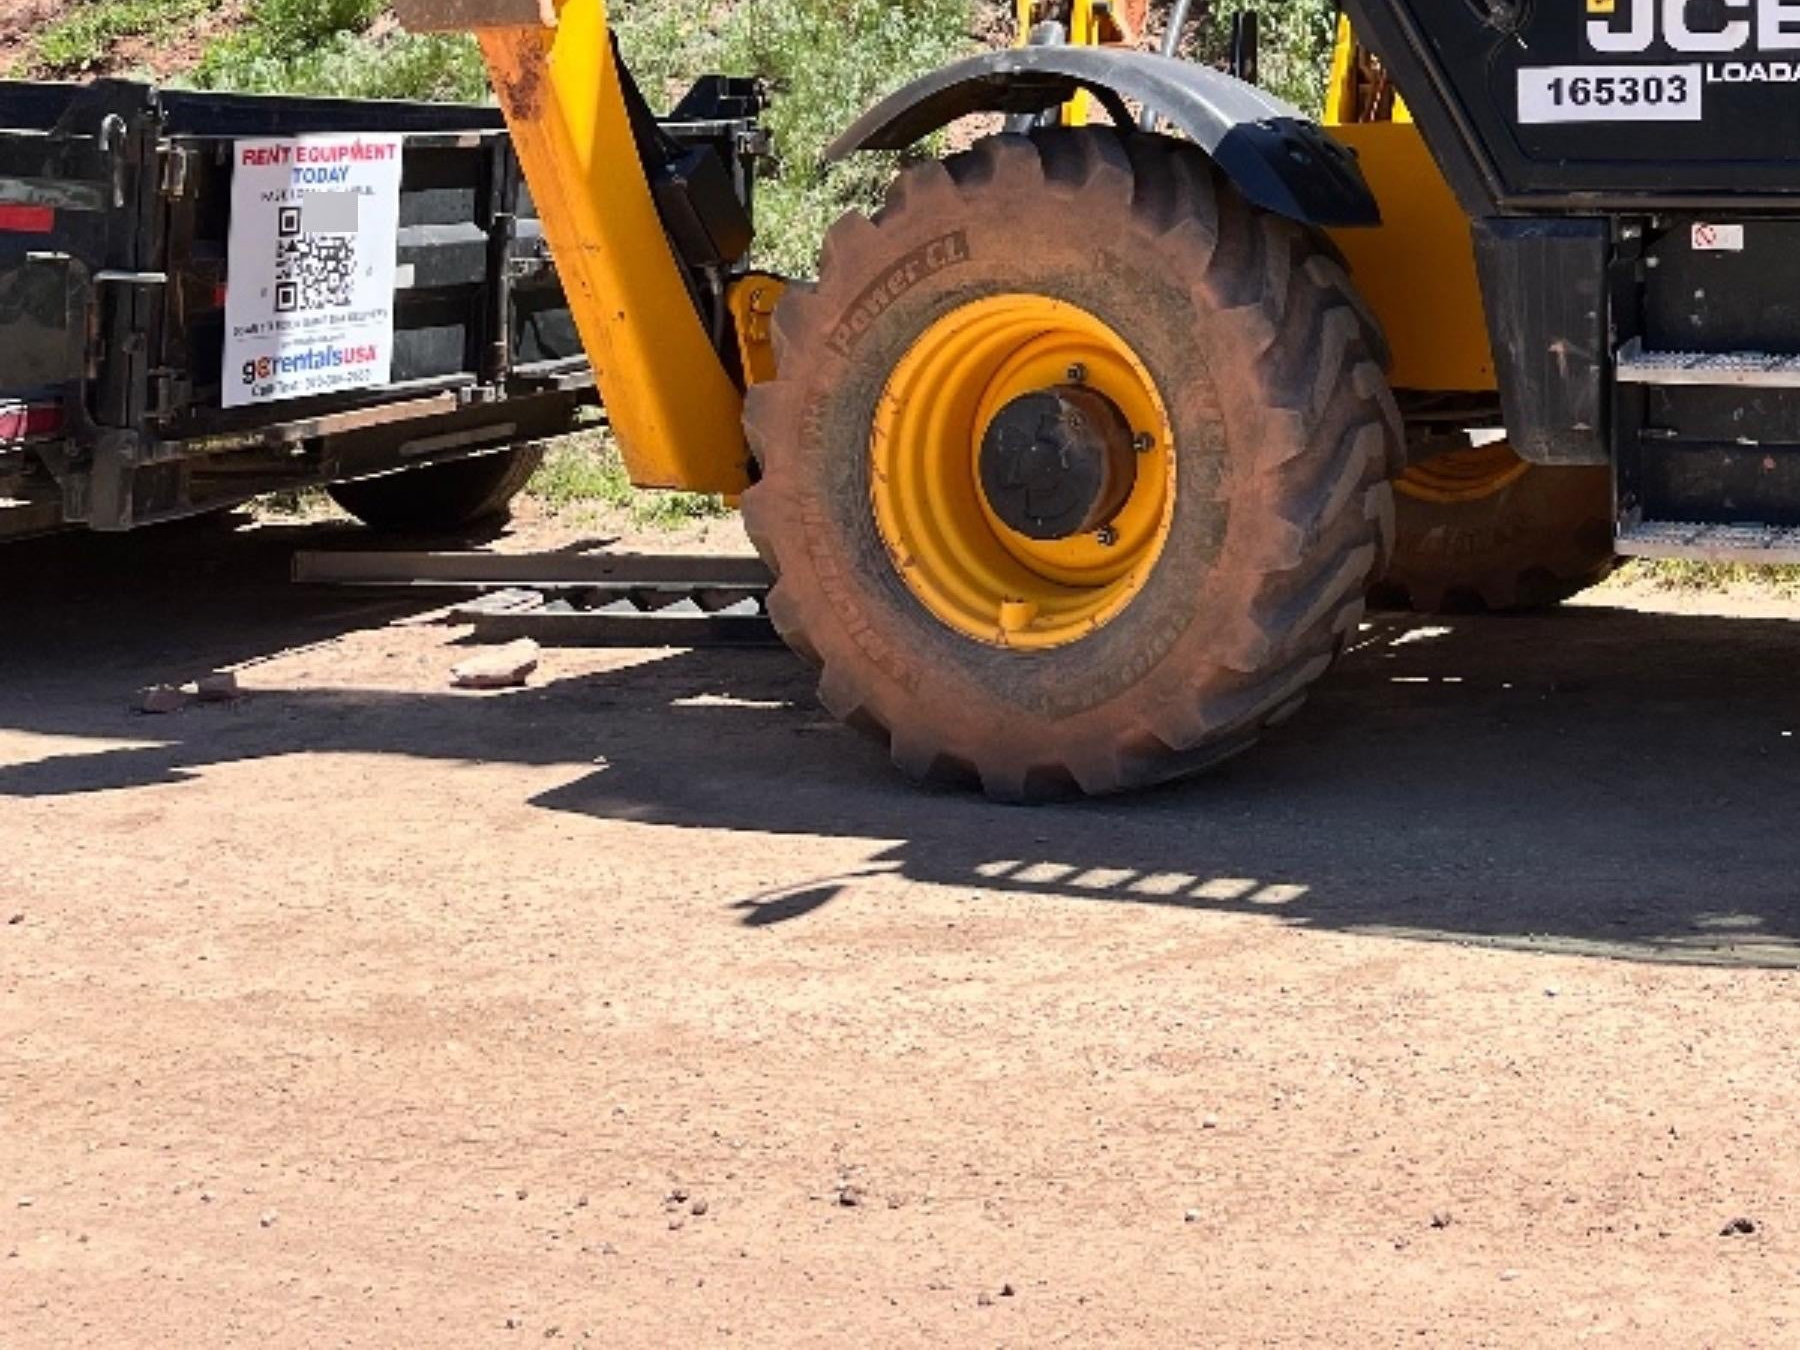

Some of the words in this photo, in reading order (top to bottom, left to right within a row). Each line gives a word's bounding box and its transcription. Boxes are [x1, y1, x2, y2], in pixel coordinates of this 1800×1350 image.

[1547, 75, 1688, 106] 165303
[242, 145, 292, 166] RENT
[295, 142, 397, 163] EQUIPMENT
[292, 166, 350, 184] TODAY
